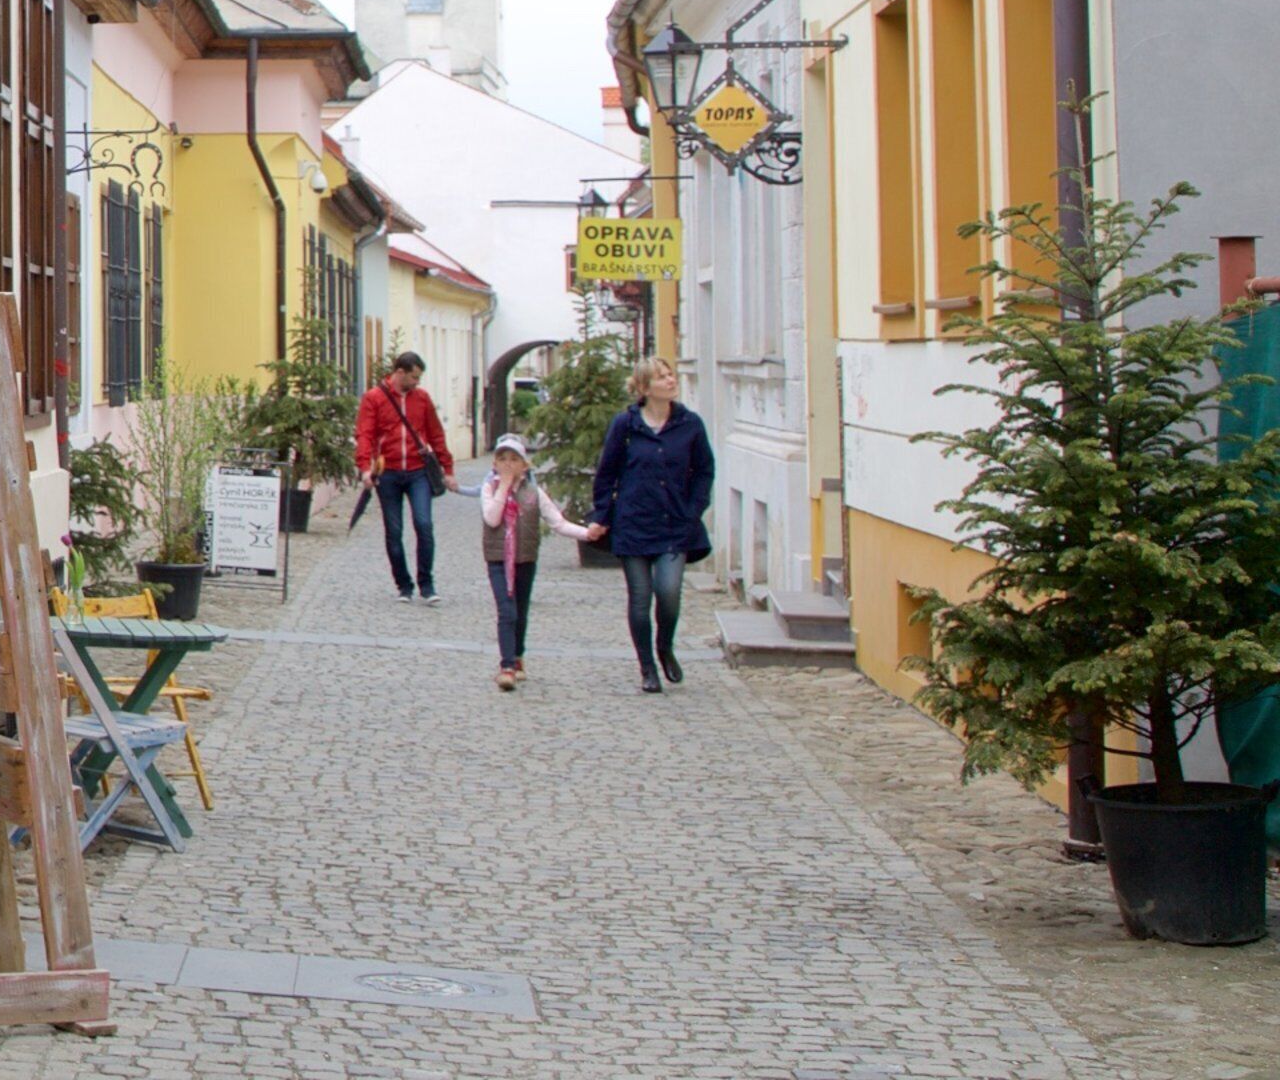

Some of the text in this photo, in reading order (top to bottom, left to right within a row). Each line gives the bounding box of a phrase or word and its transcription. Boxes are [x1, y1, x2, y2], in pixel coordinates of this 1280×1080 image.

[705, 107, 755, 121] TOPAS
[584, 226, 674, 241] OPRAVA
[595, 243, 664, 258] OBUVI
